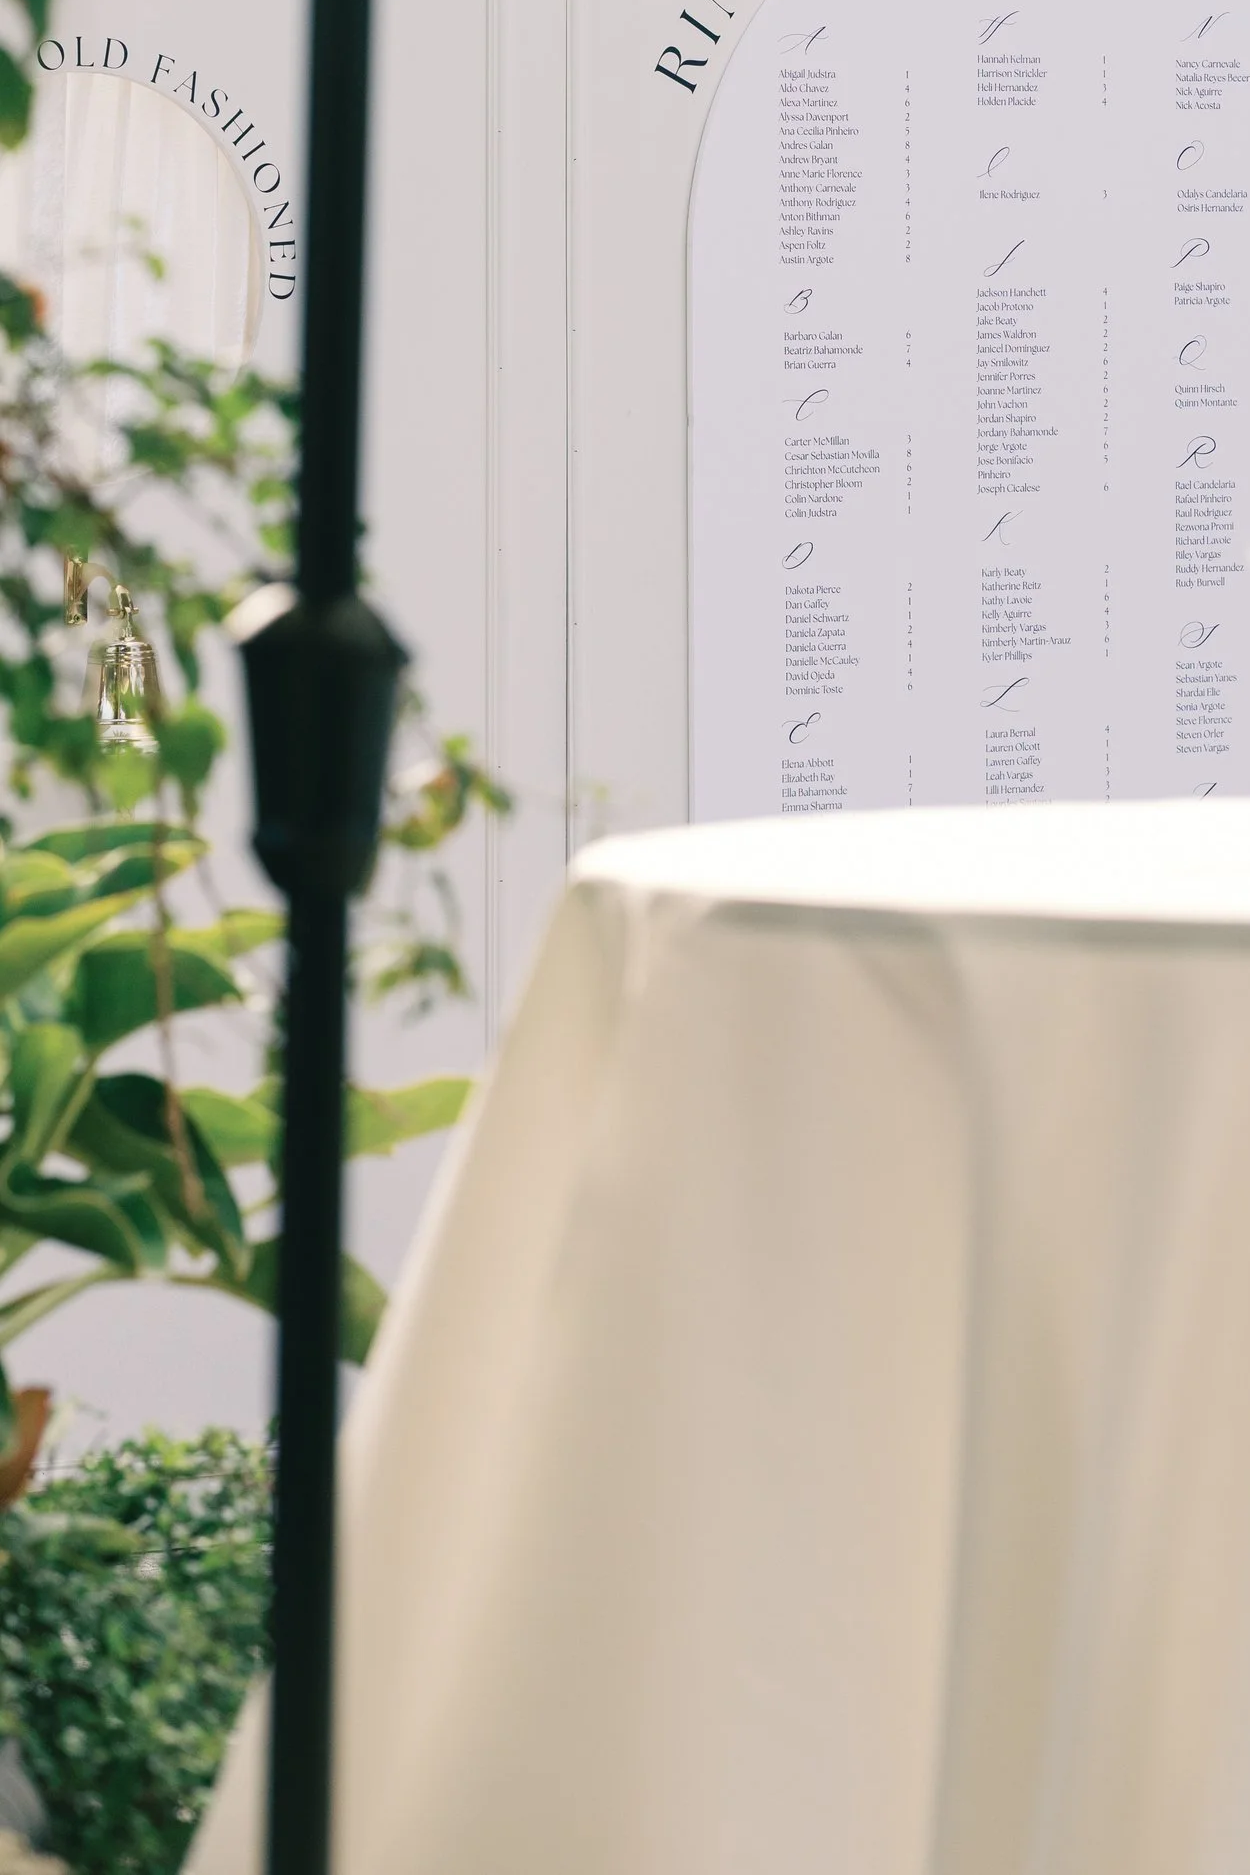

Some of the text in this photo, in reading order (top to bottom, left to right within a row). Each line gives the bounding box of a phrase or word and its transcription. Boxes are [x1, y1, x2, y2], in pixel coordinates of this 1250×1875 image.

[1179, 11, 1230, 43] N
[777, 25, 830, 55] A
[978, 54, 1008, 63] Hannah
[1176, 60, 1200, 70] Nancy
[1202, 59, 1240, 68] Carnevale
[778, 69, 805, 81] Abigail
[978, 69, 1012, 77] Harrison
[1014, 68, 1047, 78] Strickler
[1176, 73, 1202, 82] Natalia
[1204, 74, 1226, 84] Reyes
[779, 83, 797, 92] Aldo
[799, 83, 829, 93] Chavez
[995, 82, 1038, 92] Hernandez
[1176, 87, 1192, 96] Nick
[1194, 87, 1222, 99] Aguirre
[779, 97, 800, 107] Alexa
[802, 98, 838, 107] Martinez
[978, 96, 1006, 106] Holden
[1176, 100, 1193, 109] Nick
[779, 112, 804, 123] Alyssa
[806, 112, 848, 124] Davenport
[779, 126, 795, 135] Ana
[797, 126, 824, 135] Cecilia
[826, 126, 859, 137] Pinheiro
[779, 140, 807, 149] Andres
[809, 140, 833, 149] Galan
[779, 154, 811, 164] Andrew
[811, 155, 839, 165] Bryant
[1176, 139, 1205, 171] O
[37, 36, 297, 300] OLD FASHIONED
[779, 170, 800, 178] Anne
[802, 169, 825, 178] Marie
[827, 169, 863, 178] Florence
[779, 183, 814, 194] Anthony
[816, 183, 856, 193] Carnevale
[1001, 189, 1040, 201] Rodriguez
[1177, 189, 1204, 200] Odalys
[1206, 189, 1247, 198] Candelaria
[779, 197, 814, 209] Anthony
[816, 197, 856, 209] Rodriguez
[1177, 203, 1199, 212] Osiris
[1201, 203, 1243, 213] Hernandez
[779, 213, 804, 221] Anton
[779, 226, 806, 237] Ashley
[779, 240, 804, 252] Aspen
[1169, 237, 1210, 269] P
[779, 255, 805, 265] Austin
[807, 256, 834, 266] Argote
[1174, 282, 1194, 294] Paige
[1196, 281, 1225, 293] Shapiro
[783, 288, 813, 315] B
[1175, 297, 1202, 305] Patricia
[1204, 297, 1230, 307] Argote
[784, 331, 817, 341] Barbaro
[819, 331, 842, 340] Galan
[784, 346, 812, 355] Beatriz
[814, 344, 863, 355] Bahamonde
[1172, 334, 1208, 371] Q
[784, 361, 806, 369] Brian
[807, 360, 836, 369] Guerra
[1175, 385, 1198, 395] Quinn
[1201, 383, 1225, 393] Hirsch
[781, 388, 830, 422] C
[1175, 399, 1199, 409] Quinn
[977, 413, 1005, 424] Jordan
[1004, 413, 1036, 426] Shapiro
[781, 541, 814, 570] D
[982, 623, 1018, 634] Kimberly
[1020, 622, 1047, 635] Vargas
[1176, 661, 1195, 669] Sean
[1196, 661, 1223, 671] Argote
[1176, 702, 1198, 711] Sonia
[1199, 702, 1225, 713] Argote
[781, 711, 821, 745] E
[1176, 745, 1202, 753] Steven
[1203, 743, 1229, 754] Vargas
[782, 759, 804, 769] Elena
[806, 758, 834, 769] Abbott
[782, 773, 818, 783] Elizabeth
[821, 773, 835, 783] Ray
[782, 788, 796, 797] Ella
[798, 785, 847, 797] Bahamonde
